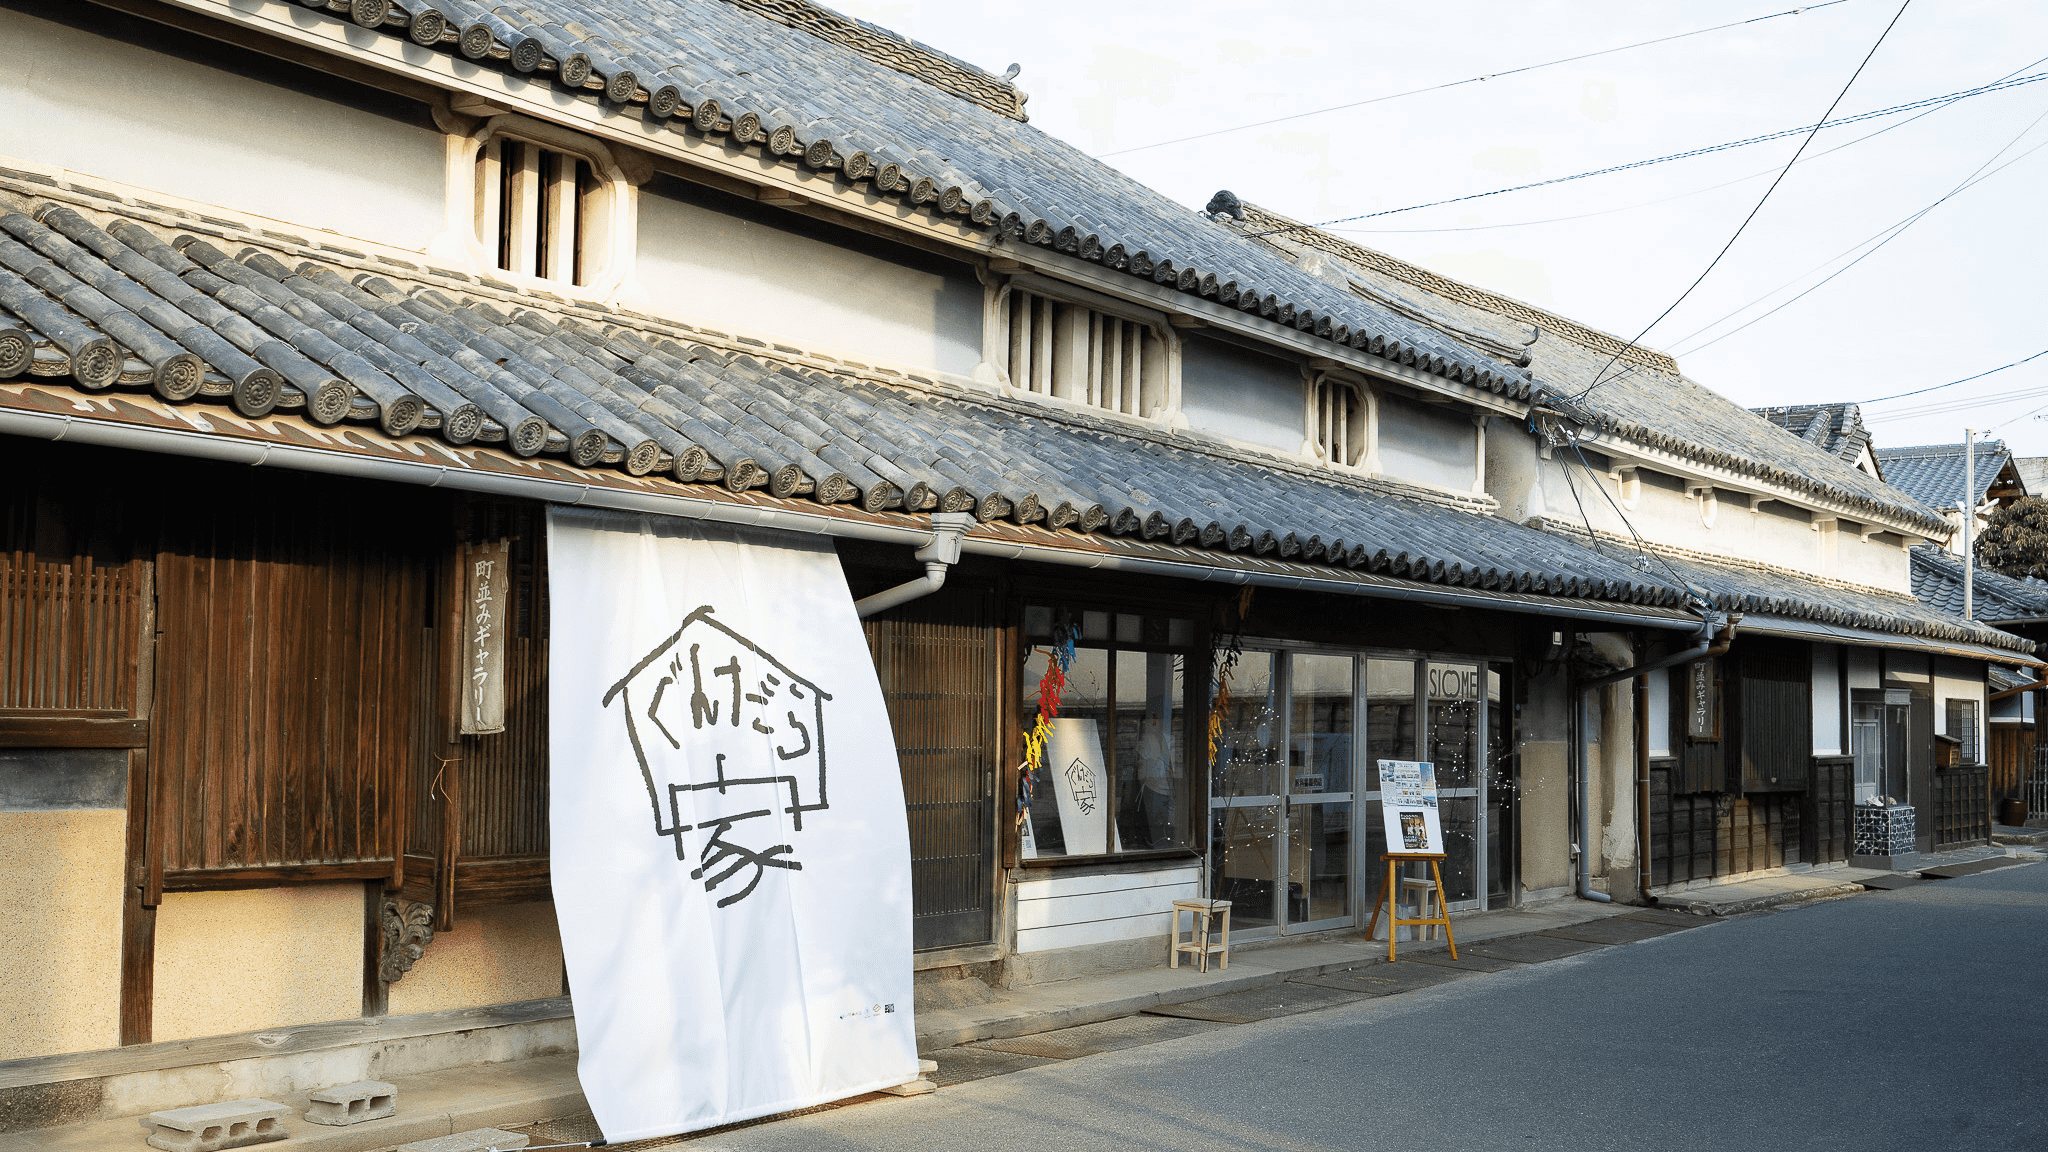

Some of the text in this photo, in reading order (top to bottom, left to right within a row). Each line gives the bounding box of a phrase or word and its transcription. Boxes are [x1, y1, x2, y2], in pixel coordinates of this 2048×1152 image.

[473, 560, 495, 721] 町並みギャラリー
[1694, 662, 1706, 733] 町並みギャラリー
